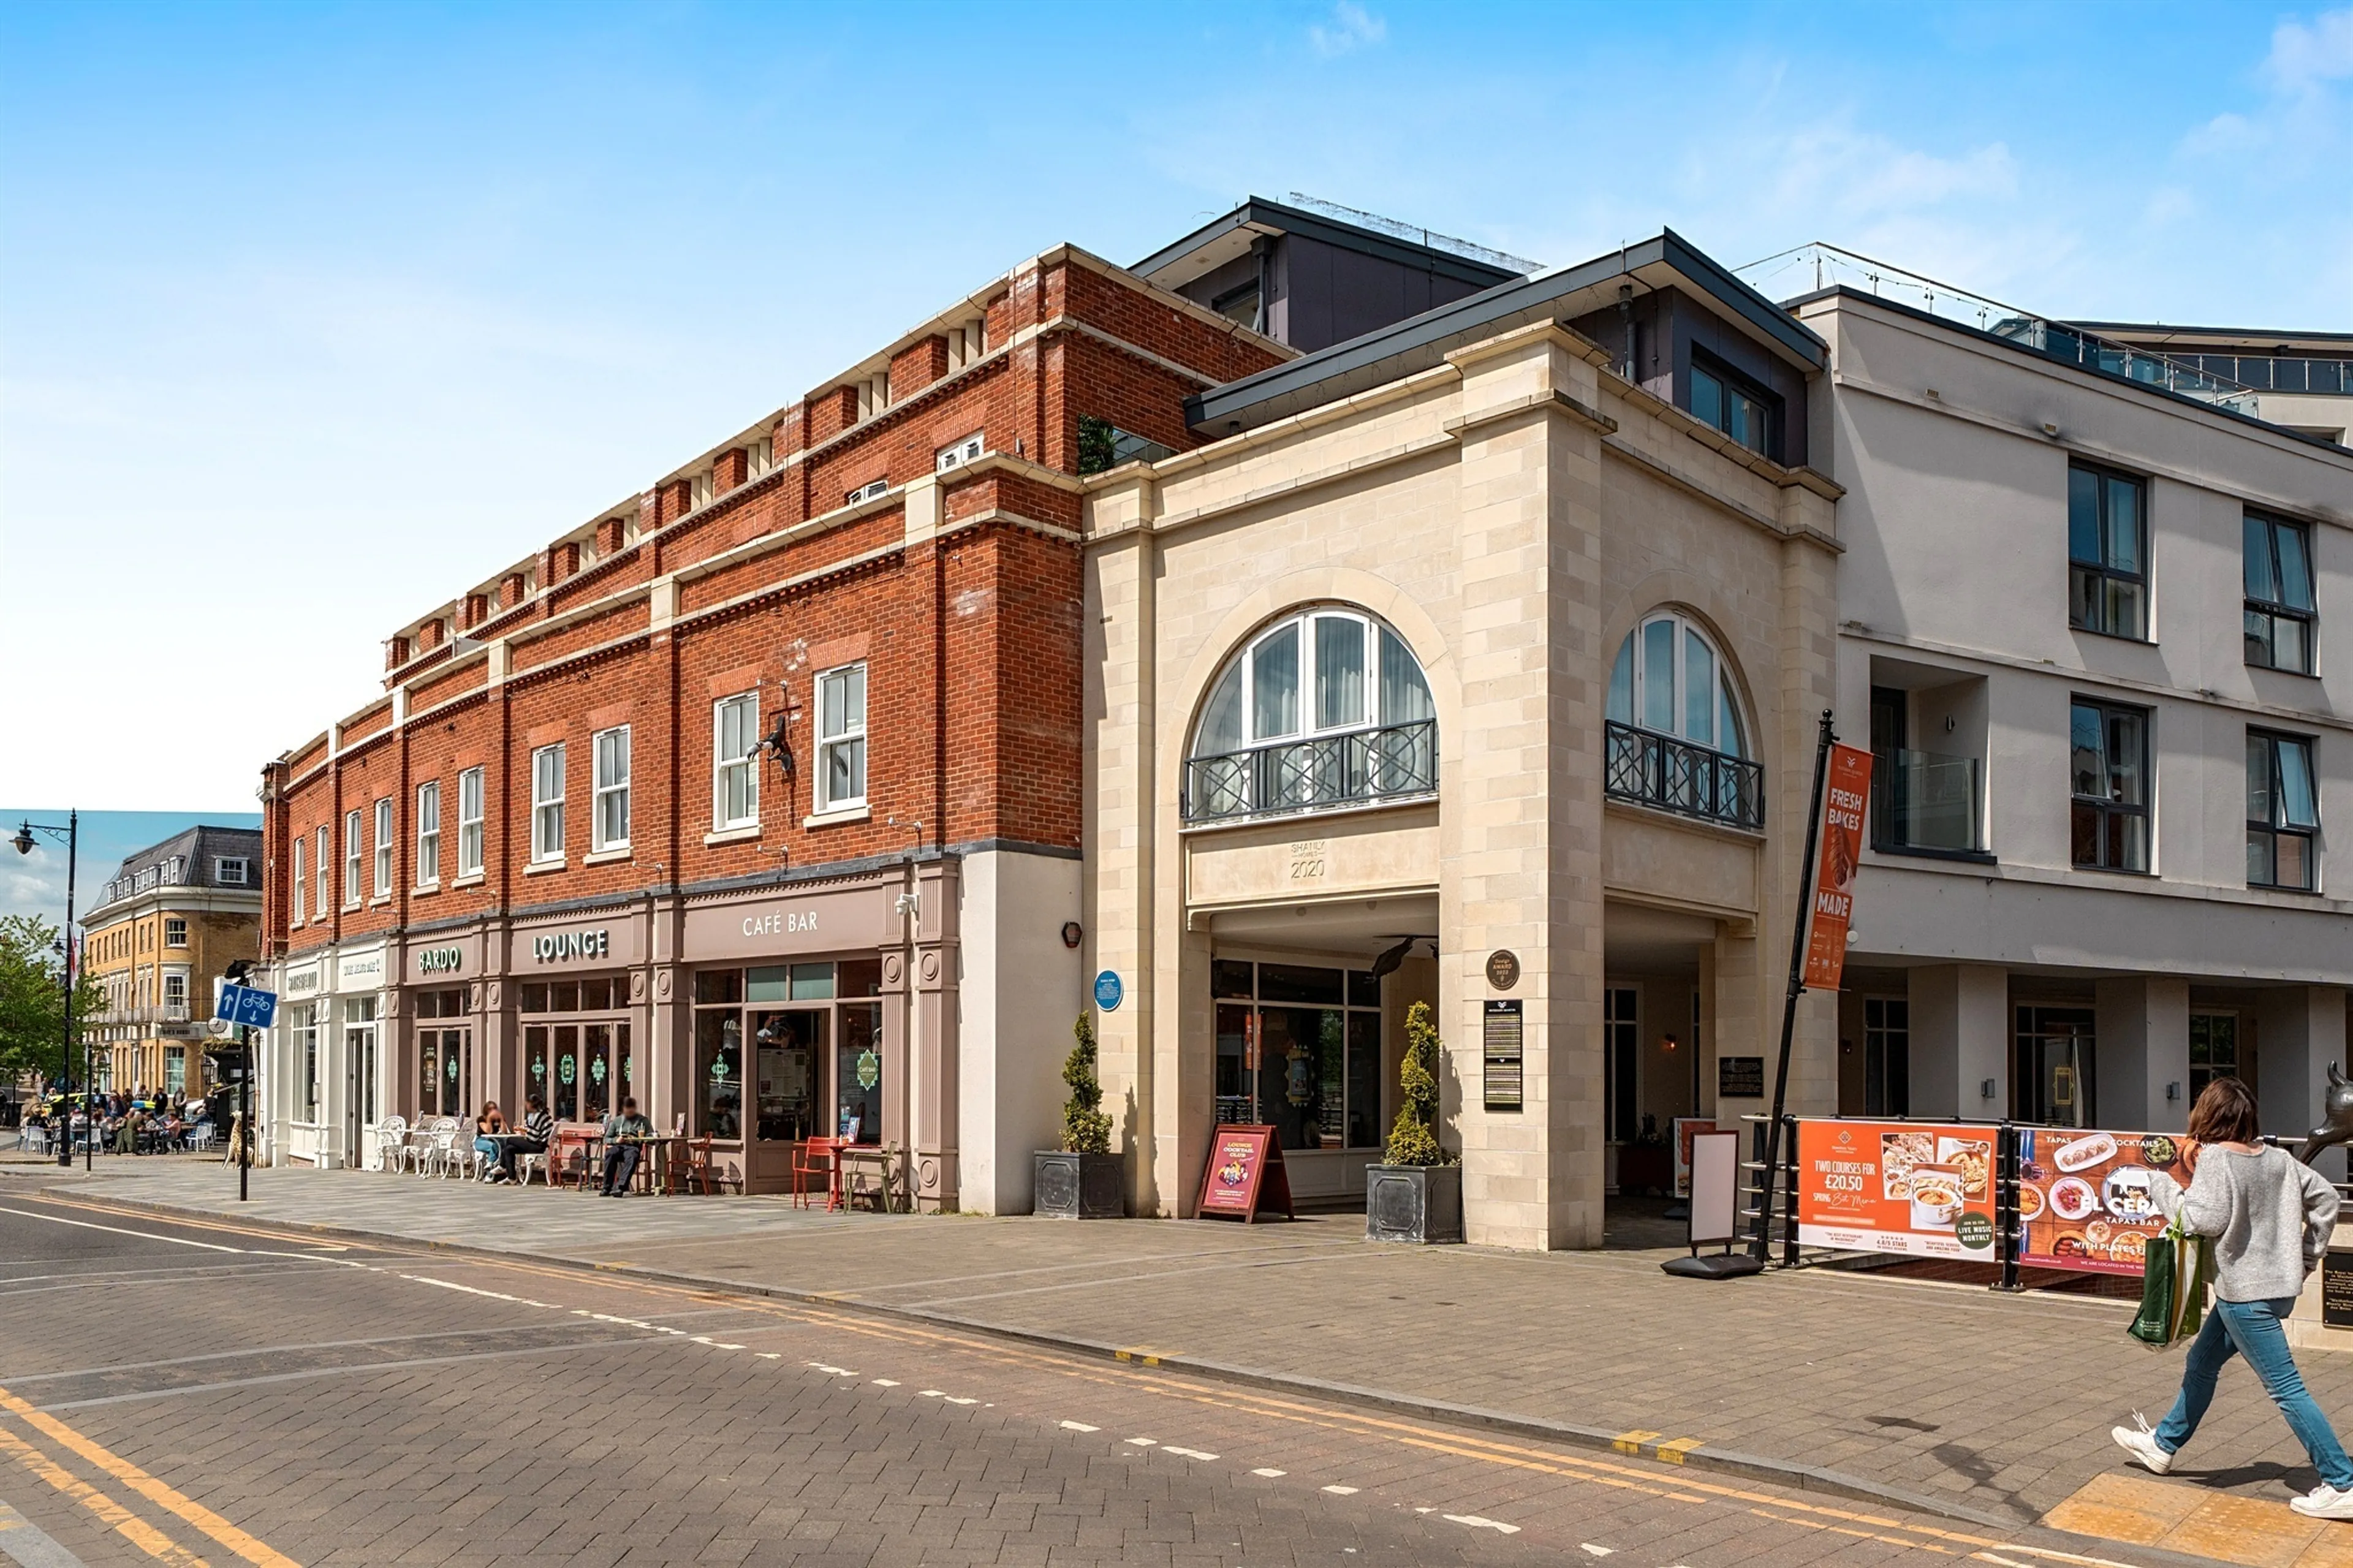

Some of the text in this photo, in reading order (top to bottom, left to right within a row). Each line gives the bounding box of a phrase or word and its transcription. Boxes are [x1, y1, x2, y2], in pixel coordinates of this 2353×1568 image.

[1830, 787, 1863, 811] FRESH
[1828, 808, 1860, 831] BAKES
[1291, 859, 1325, 879] 2020
[1817, 892, 1849, 917] MADE
[743, 909, 818, 937] CAFÉ BAR
[532, 929, 607, 959] LOUNGE
[418, 946, 460, 971] BARDO
[2045, 1136, 2072, 1145] TAPAS
[2110, 1139, 2159, 1148] COCKTAILS
[1814, 1160, 1876, 1175] TWO COURSES FOR
[1825, 1174, 1863, 1191] £20.50
[2080, 1195, 2104, 1211] EL
[2105, 1216, 2136, 1225] TAPAS
[2072, 1241, 2097, 1250] WITH
[2100, 1243, 2135, 1253] PLATES
